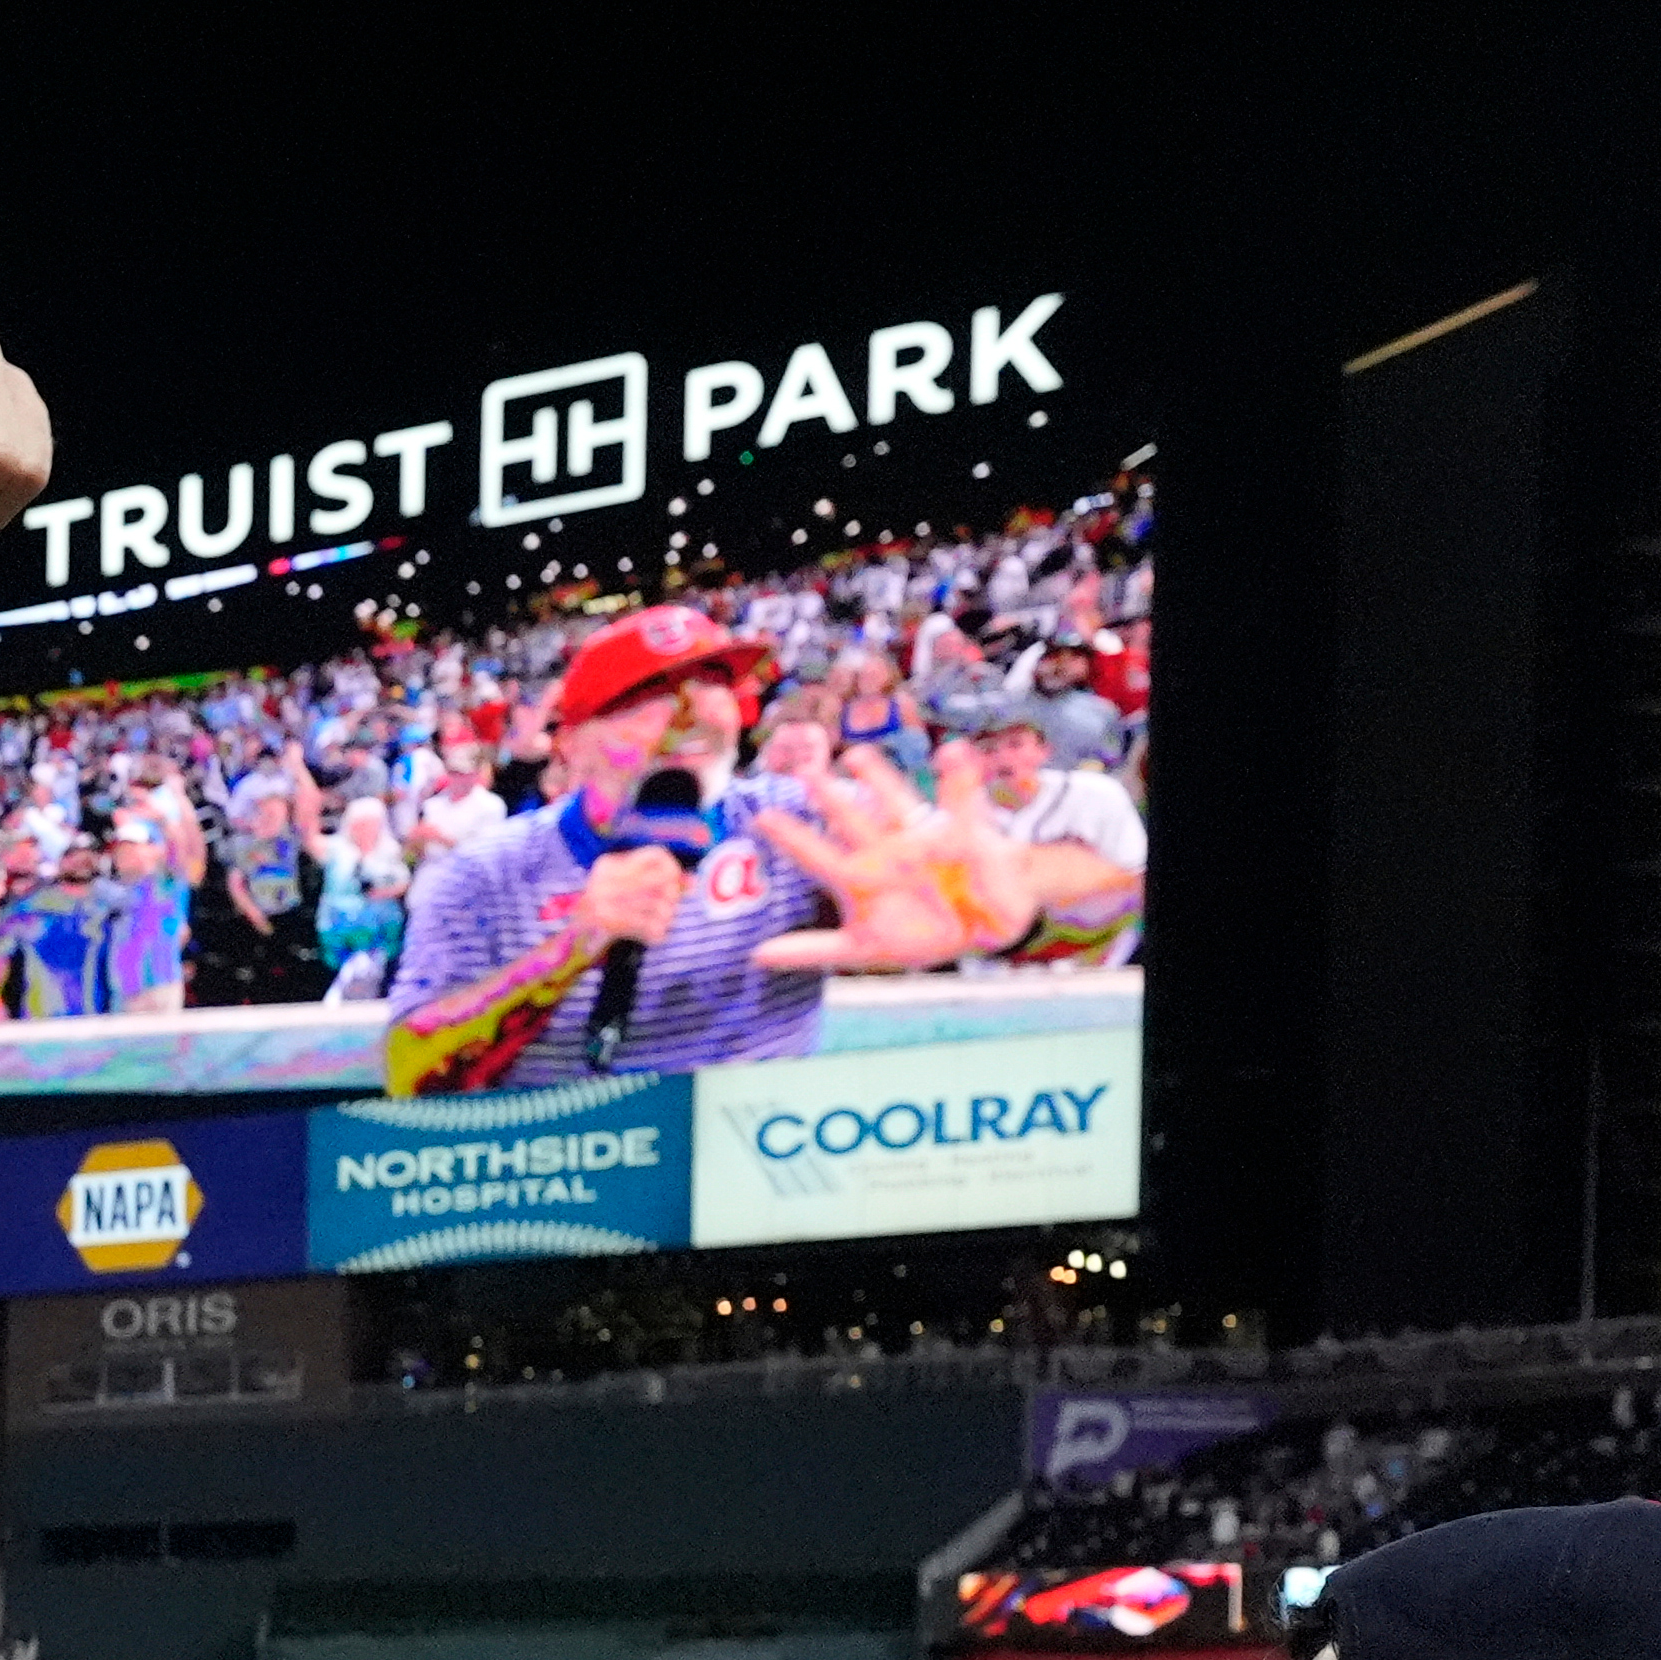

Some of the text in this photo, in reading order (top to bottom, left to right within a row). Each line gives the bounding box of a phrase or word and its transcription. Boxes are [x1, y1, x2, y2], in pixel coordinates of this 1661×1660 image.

[23, 291, 1066, 588] TRUIST PARK
[756, 1083, 1110, 1159] COOLRAY
[336, 1126, 660, 1190] NORTHSIDE
[82, 1178, 177, 1233] NAPA
[392, 1176, 597, 1216] HOSPITAL
[101, 1292, 238, 1338] ORIS
